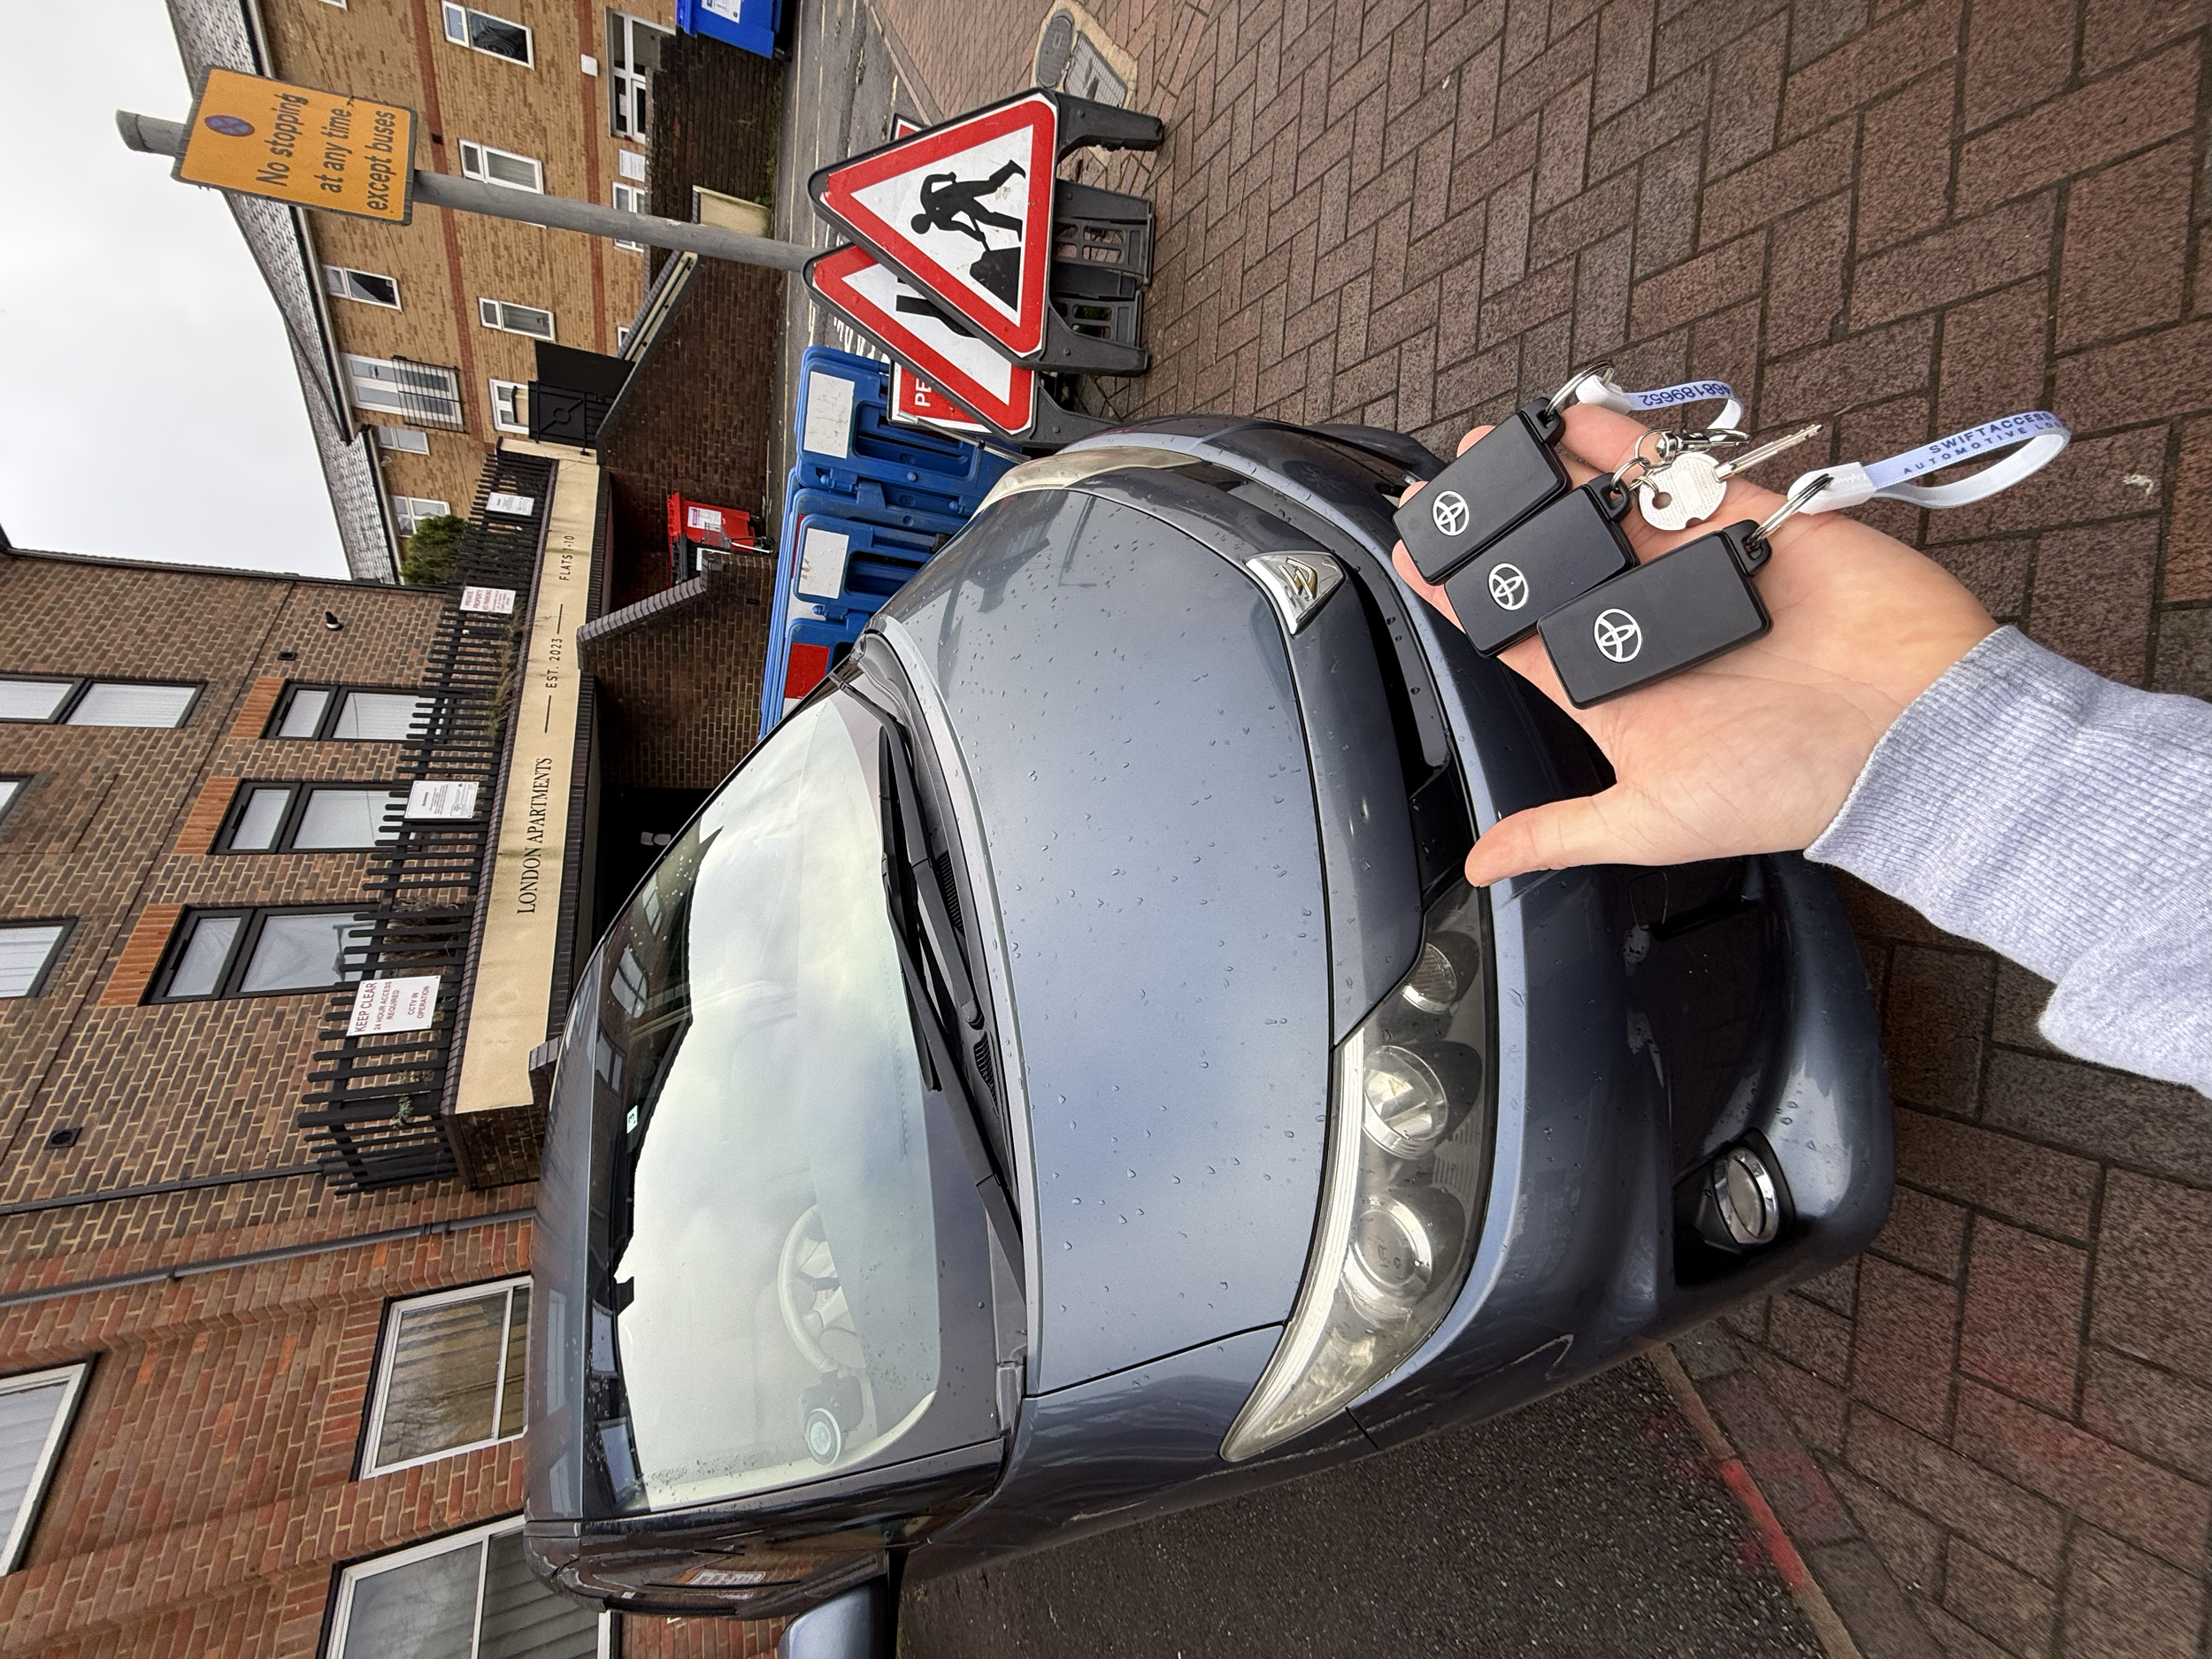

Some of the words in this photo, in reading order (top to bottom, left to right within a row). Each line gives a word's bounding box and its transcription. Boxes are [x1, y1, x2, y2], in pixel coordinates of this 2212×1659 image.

[265, 92, 310, 158] stopping
[320, 107, 351, 140] time
[365, 110, 396, 154] buses
[319, 141, 352, 172] any
[256, 159, 290, 188] No
[314, 173, 344, 194] at
[365, 155, 397, 211] except
[1638, 383, 1731, 406] 468189652
[1928, 411, 2053, 455] SWIFTACCESS
[1903, 426, 2028, 475] AUTOMOTIVE
[558, 554, 573, 581] FLATS
[549, 638, 563, 661] 2023
[545, 666, 559, 688] EST.
[526, 757, 553, 844] APARTMENTS
[517, 847, 541, 914] LONDON
[360, 982, 377, 1009] CLEAR
[380, 981, 392, 1004] ACCESS
[387, 989, 400, 1020] REQUIRED
[417, 986, 430, 1018] OPERATION
[355, 1010, 369, 1033] KEEP
[376, 1005, 386, 1023] HOUR
[407, 1000, 417, 1016] CCTV
